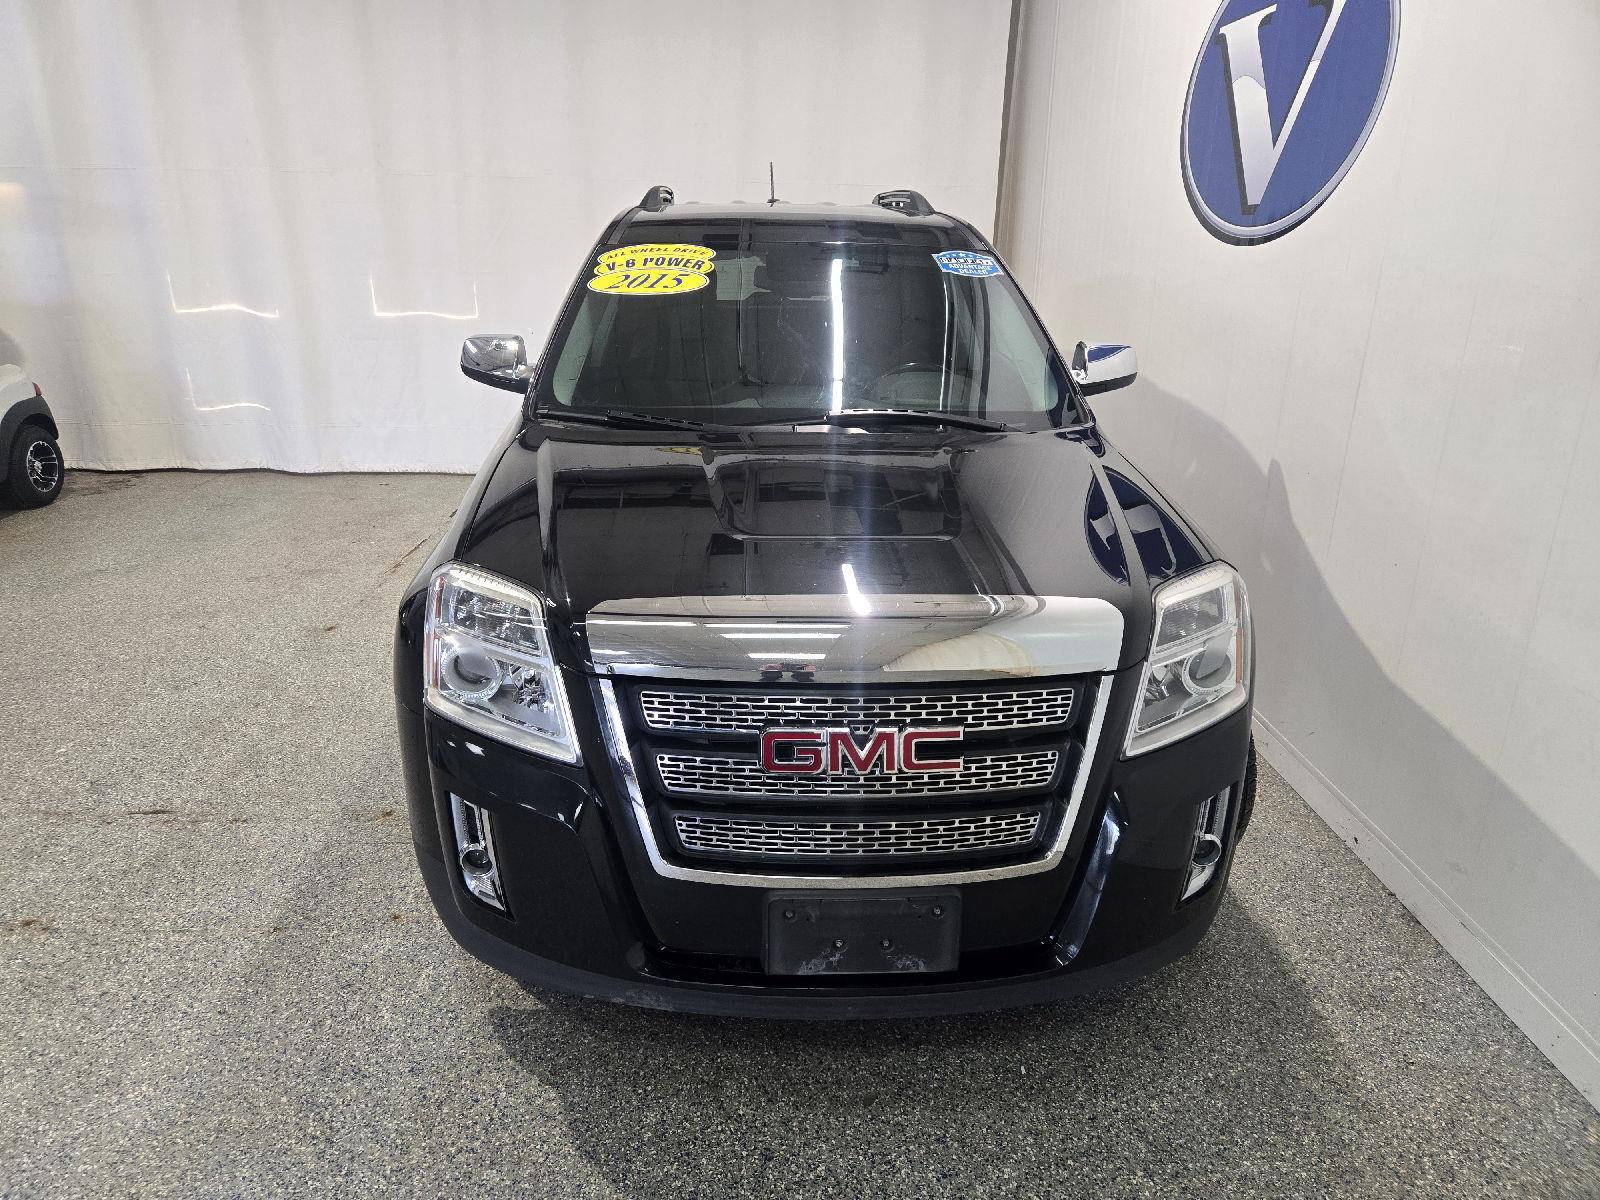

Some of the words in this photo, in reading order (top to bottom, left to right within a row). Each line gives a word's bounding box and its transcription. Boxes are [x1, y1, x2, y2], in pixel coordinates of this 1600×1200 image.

[1218, 0, 1347, 206] V
[606, 251, 625, 260] ALL
[673, 247, 708, 255] DRIVE
[605, 258, 636, 272] V-6
[642, 256, 707, 270] POWER
[604, 273, 690, 289] 2015
[760, 725, 964, 775] GMC
